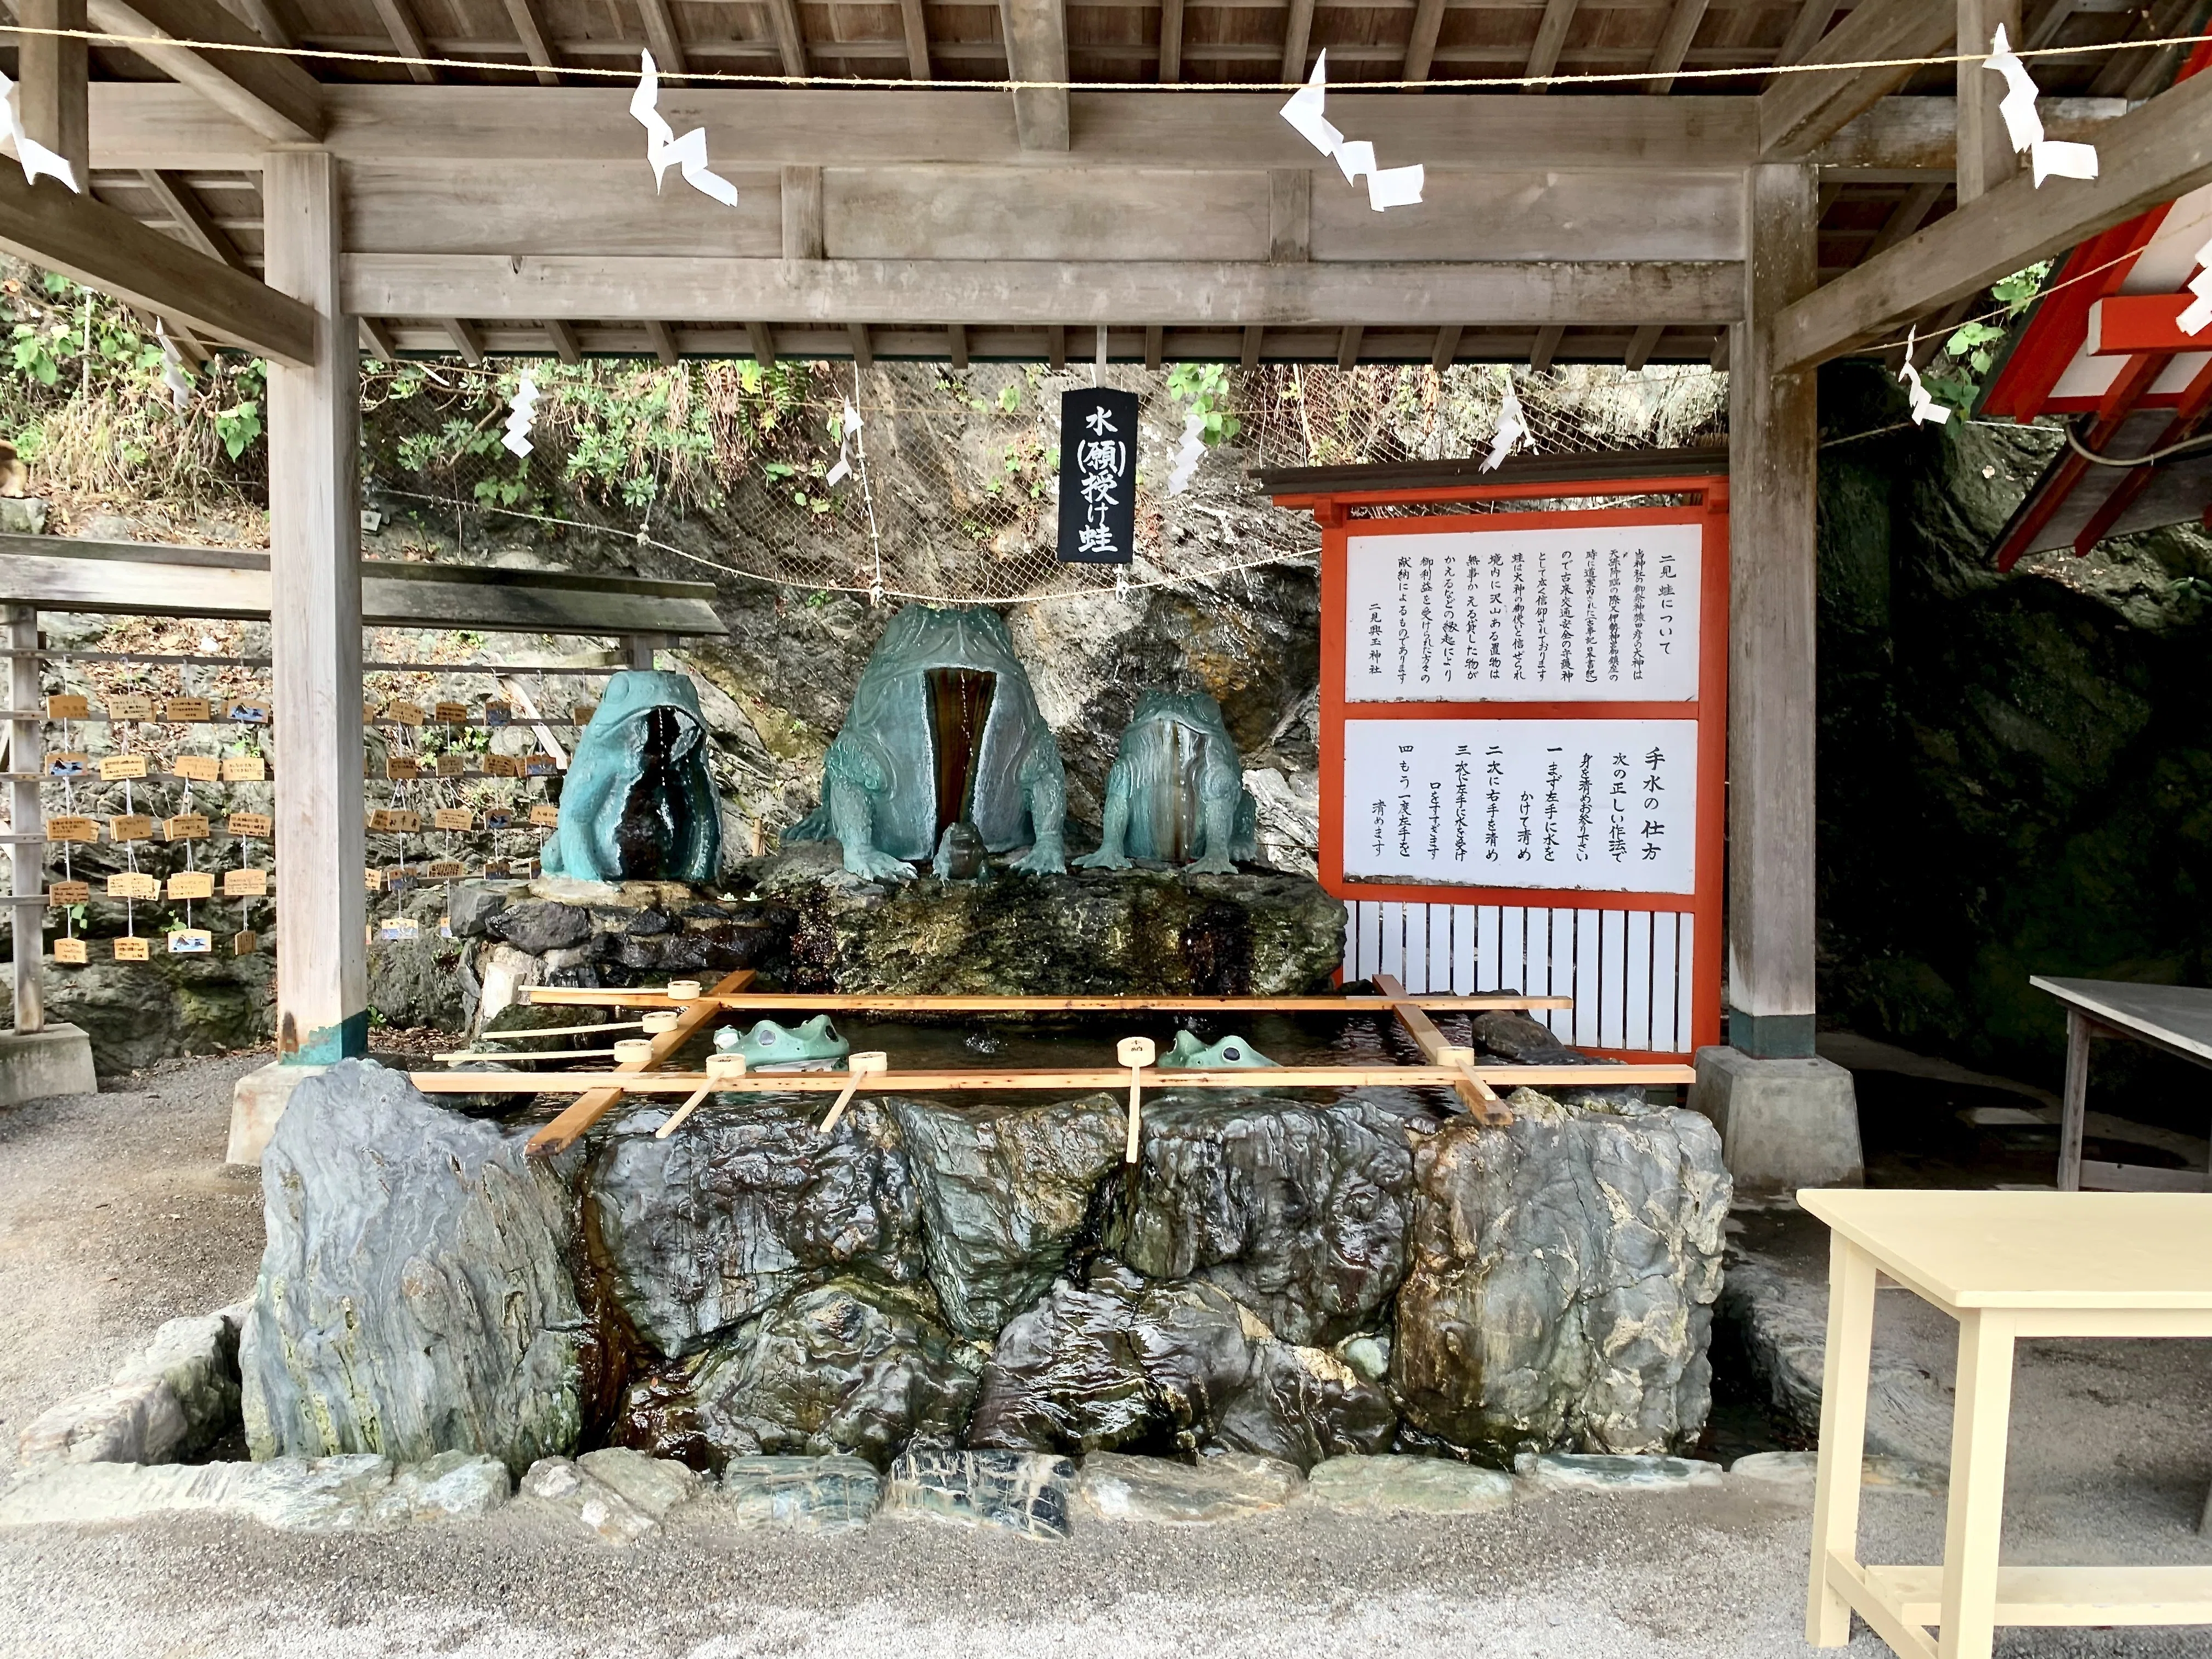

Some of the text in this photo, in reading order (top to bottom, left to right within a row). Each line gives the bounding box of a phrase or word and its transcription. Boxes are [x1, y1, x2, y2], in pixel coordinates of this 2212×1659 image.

[1368, 603, 1383, 675] 二見興玉神社
[1397, 555, 1413, 685] 献納によるものであります
[1419, 556, 1435, 684] 御利益を受けられた方々の
[1440, 555, 1460, 682] かえるなどの縁起により
[1464, 554, 1483, 680] 無事かえる貸した物が
[1487, 552, 1504, 680] 境内に沢山ある置物は
[1534, 551, 1549, 682] として広く信仰されております
[1558, 550, 1576, 684] ので古来交通安全の守護神
[1657, 555, 1677, 655] 二見蛙について
[1372, 799, 1387, 857] 清めます
[1426, 781, 1442, 860] 口をすすぎます
[1517, 790, 1534, 862] かけて清め
[1576, 752, 1594, 862] 身を清めお参り下さい
[1608, 752, 1630, 863] 次の正しい作法で
[1640, 746, 1666, 861] 手水の仕方
